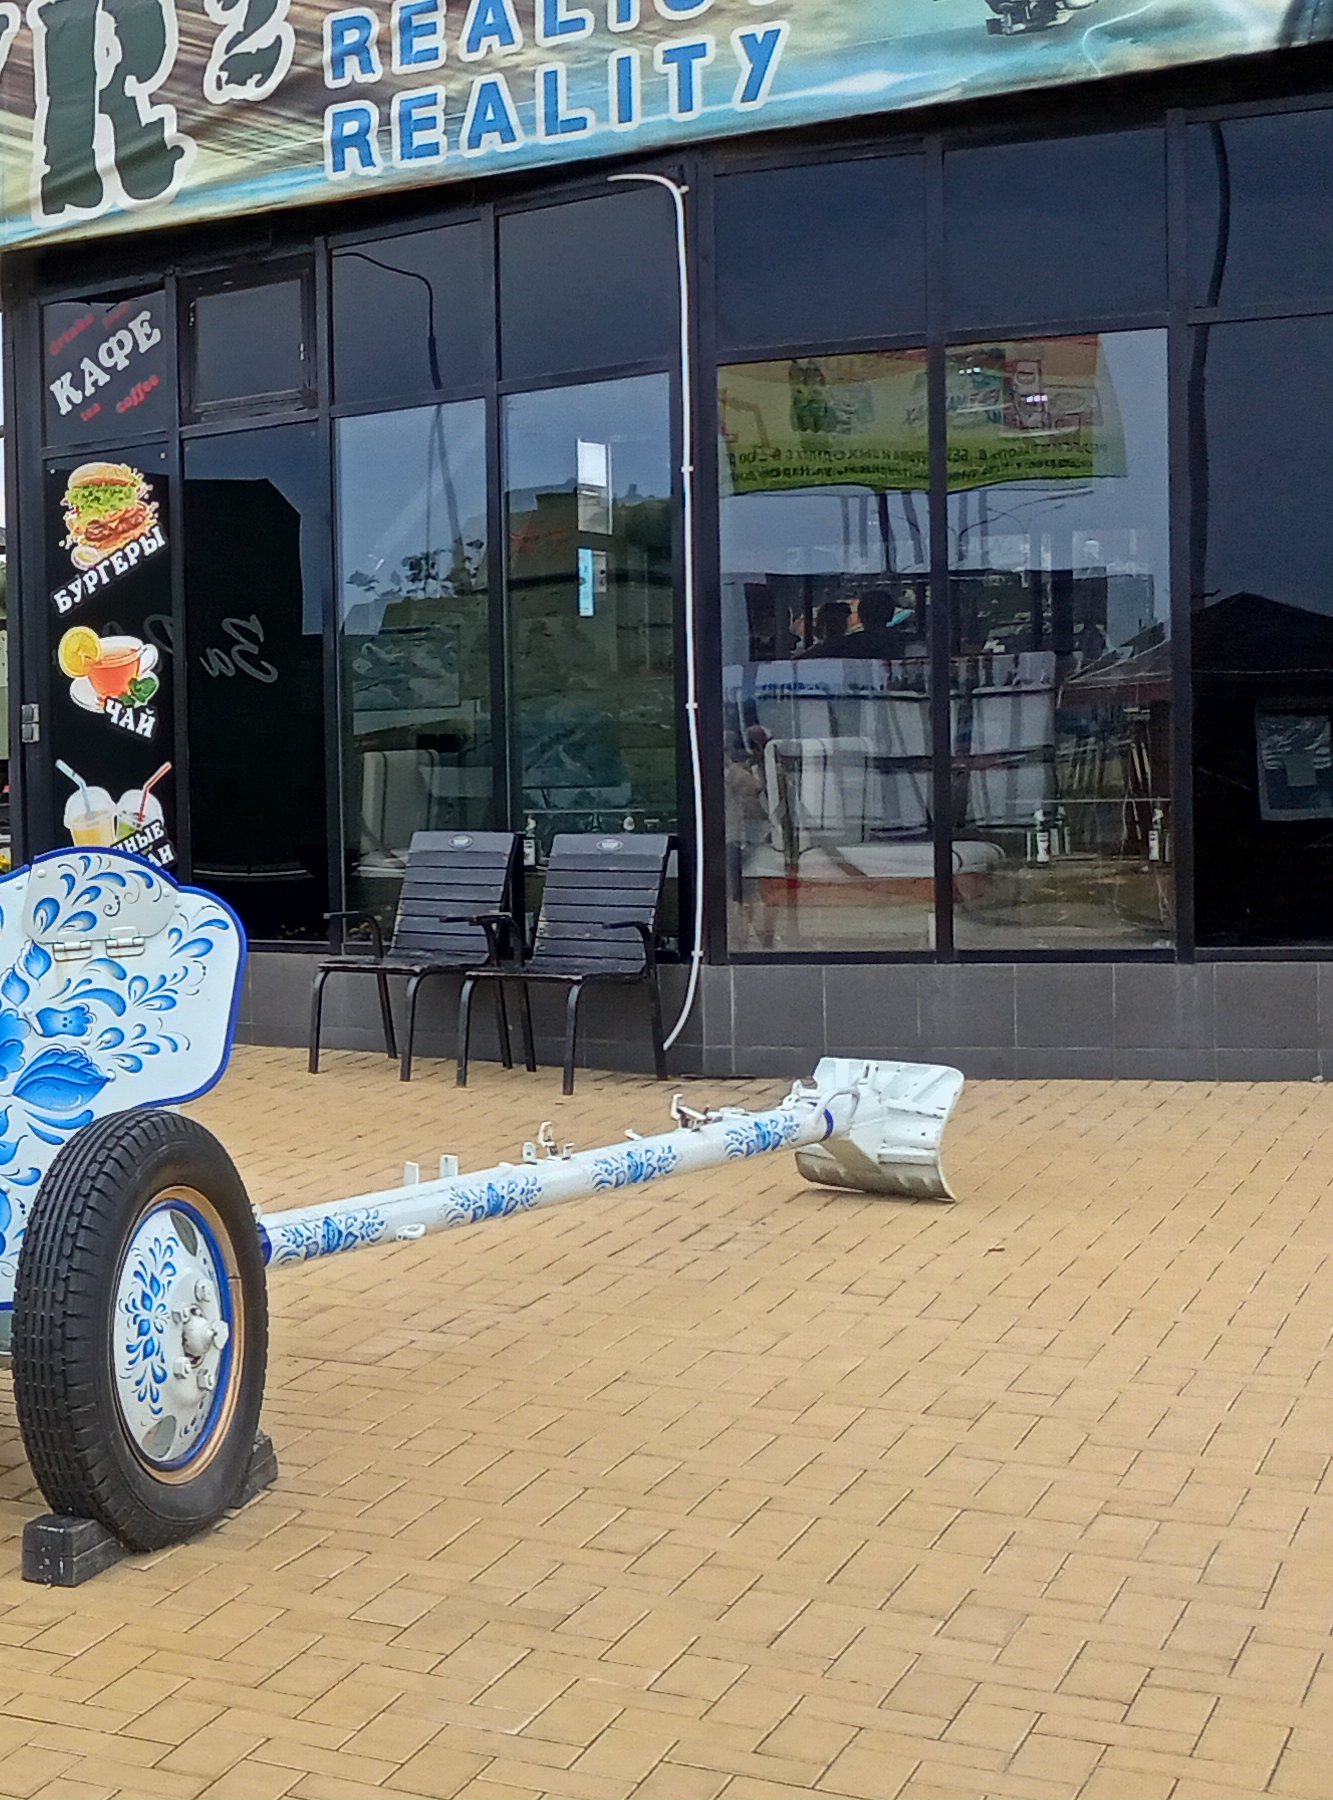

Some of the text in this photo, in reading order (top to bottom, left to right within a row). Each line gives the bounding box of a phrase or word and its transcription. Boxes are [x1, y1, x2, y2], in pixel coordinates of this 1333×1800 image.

[323, 20, 790, 178] REALITY
[49, 310, 162, 416] КАФЕ
[53, 525, 167, 614] БУРГЕРЫ
[104, 697, 157, 739] ЧАЙ
